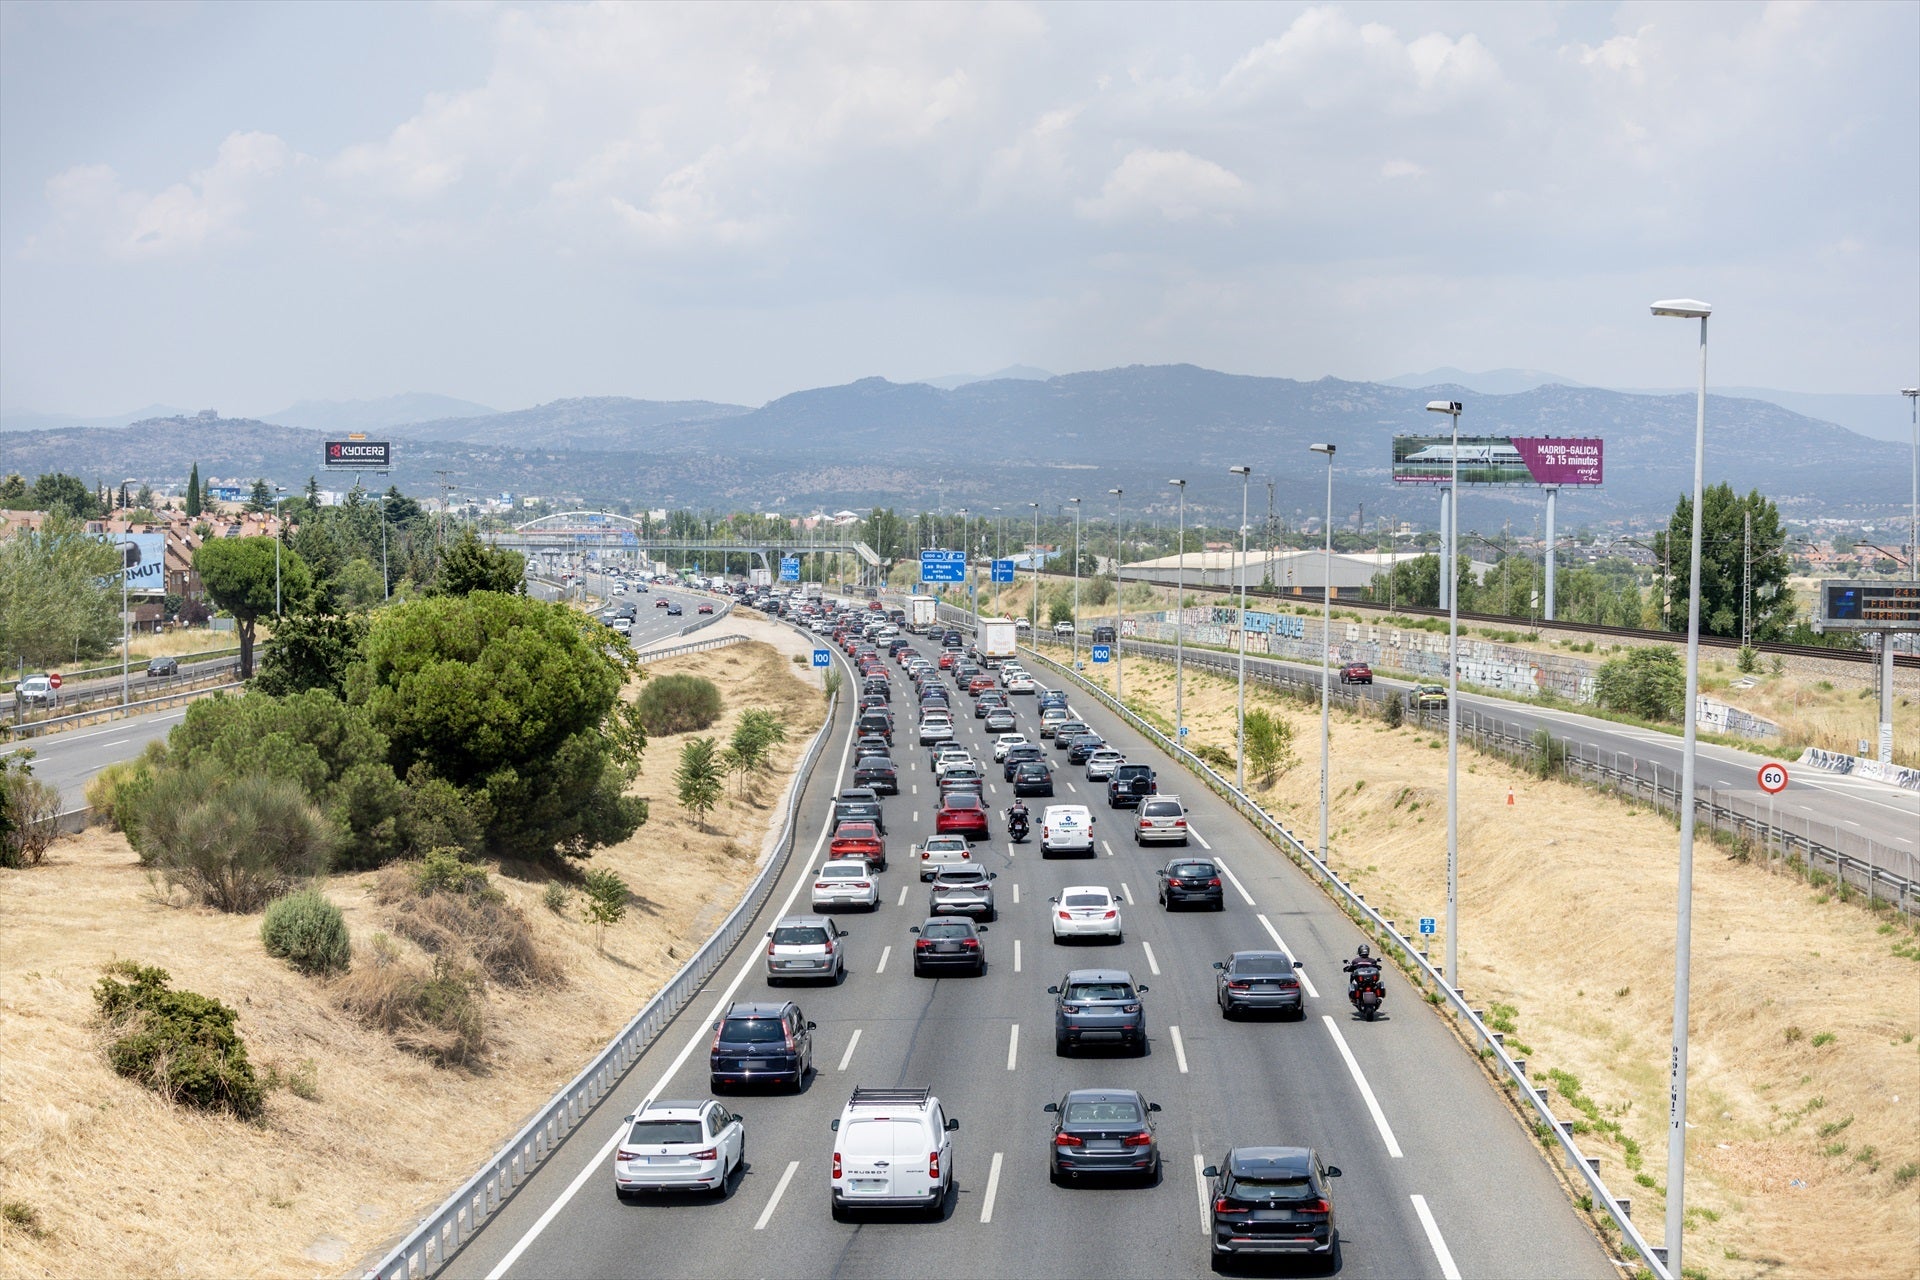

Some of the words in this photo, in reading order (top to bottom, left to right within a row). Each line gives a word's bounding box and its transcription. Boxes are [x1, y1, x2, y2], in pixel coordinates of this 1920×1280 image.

[341, 446, 385, 456] KYOCERA
[1545, 455, 1556, 465] 2h
[1558, 455, 1567, 465] 15
[1568, 456, 1599, 467] minutos
[1577, 467, 1598, 475] renfe
[1896, 588, 1917, 598] 243
[814, 654, 829, 663] 100
[1094, 650, 1108, 659] 100
[1765, 773, 1782, 783] 60
[1425, 925, 1431, 933] 2
